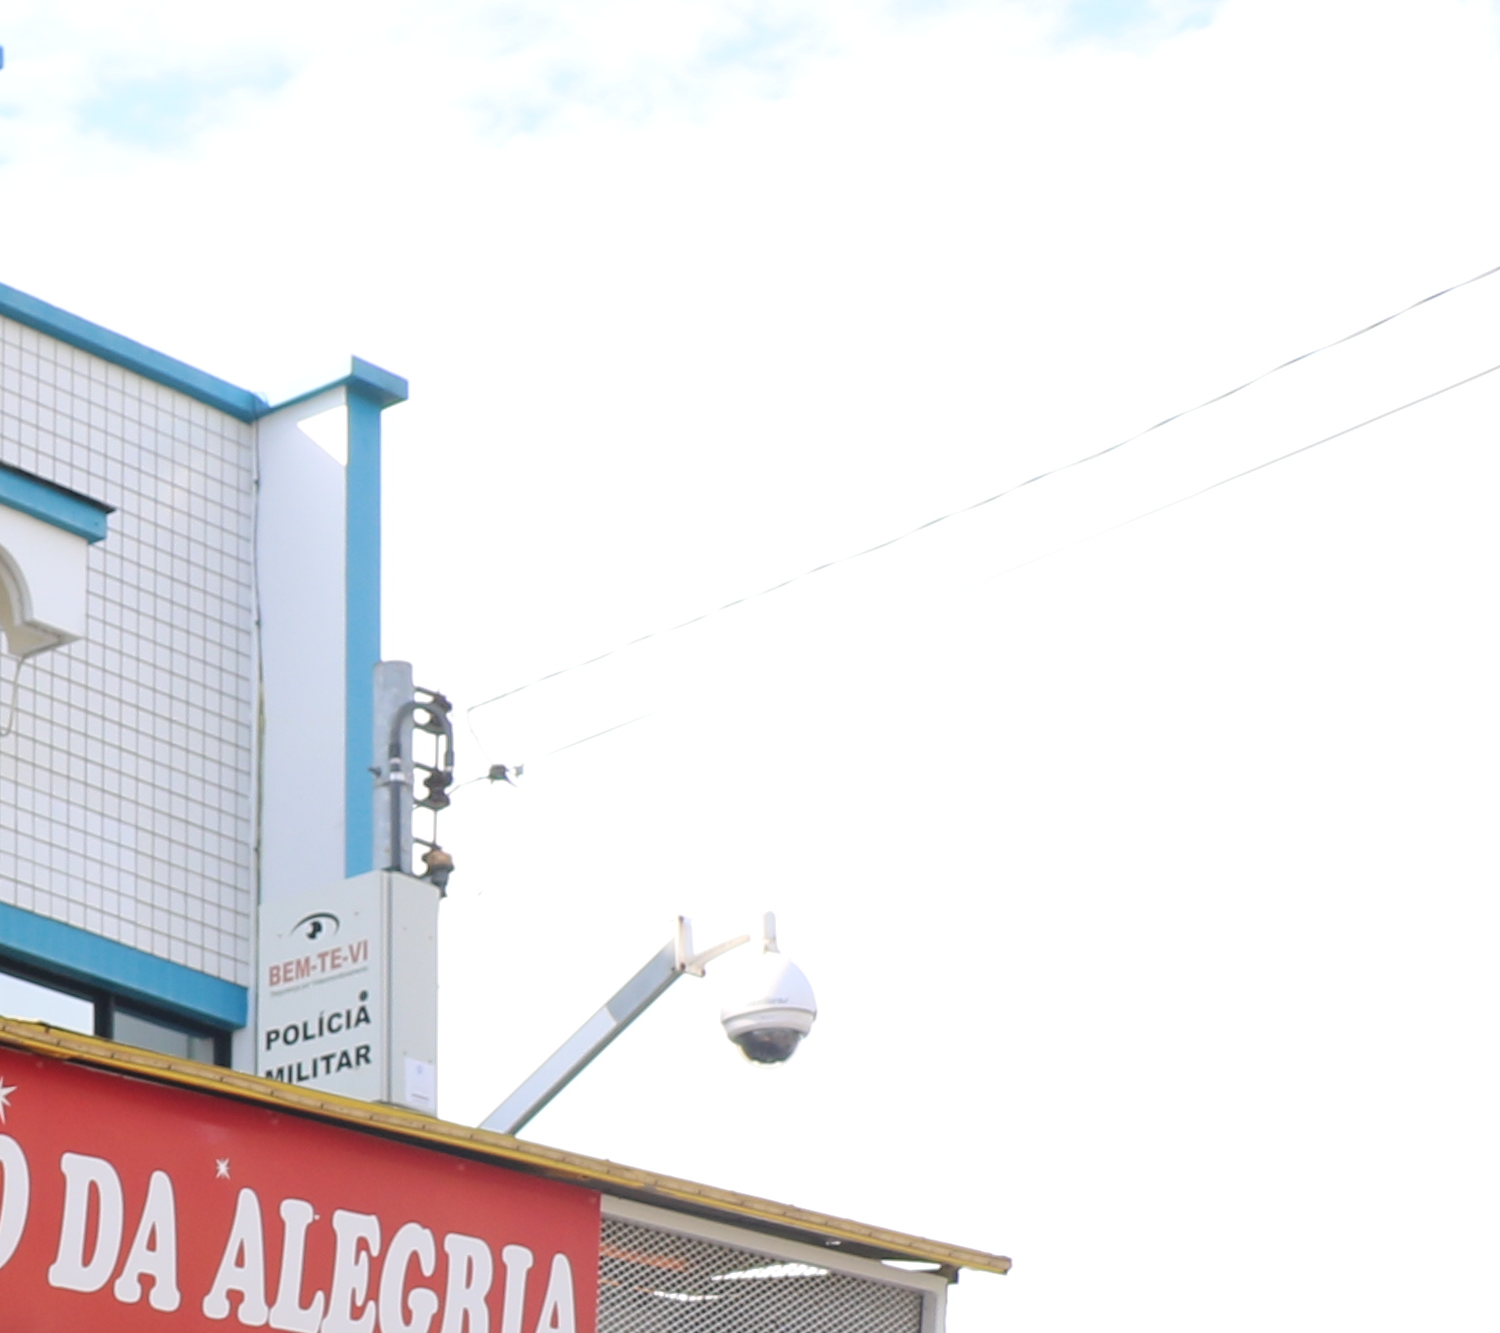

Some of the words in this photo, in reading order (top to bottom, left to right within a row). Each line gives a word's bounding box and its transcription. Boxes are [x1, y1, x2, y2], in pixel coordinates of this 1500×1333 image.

[269, 940, 368, 987] BEM-TE-VI
[265, 1005, 371, 1051] POLÍCIA
[49, 1151, 180, 1312] DA
